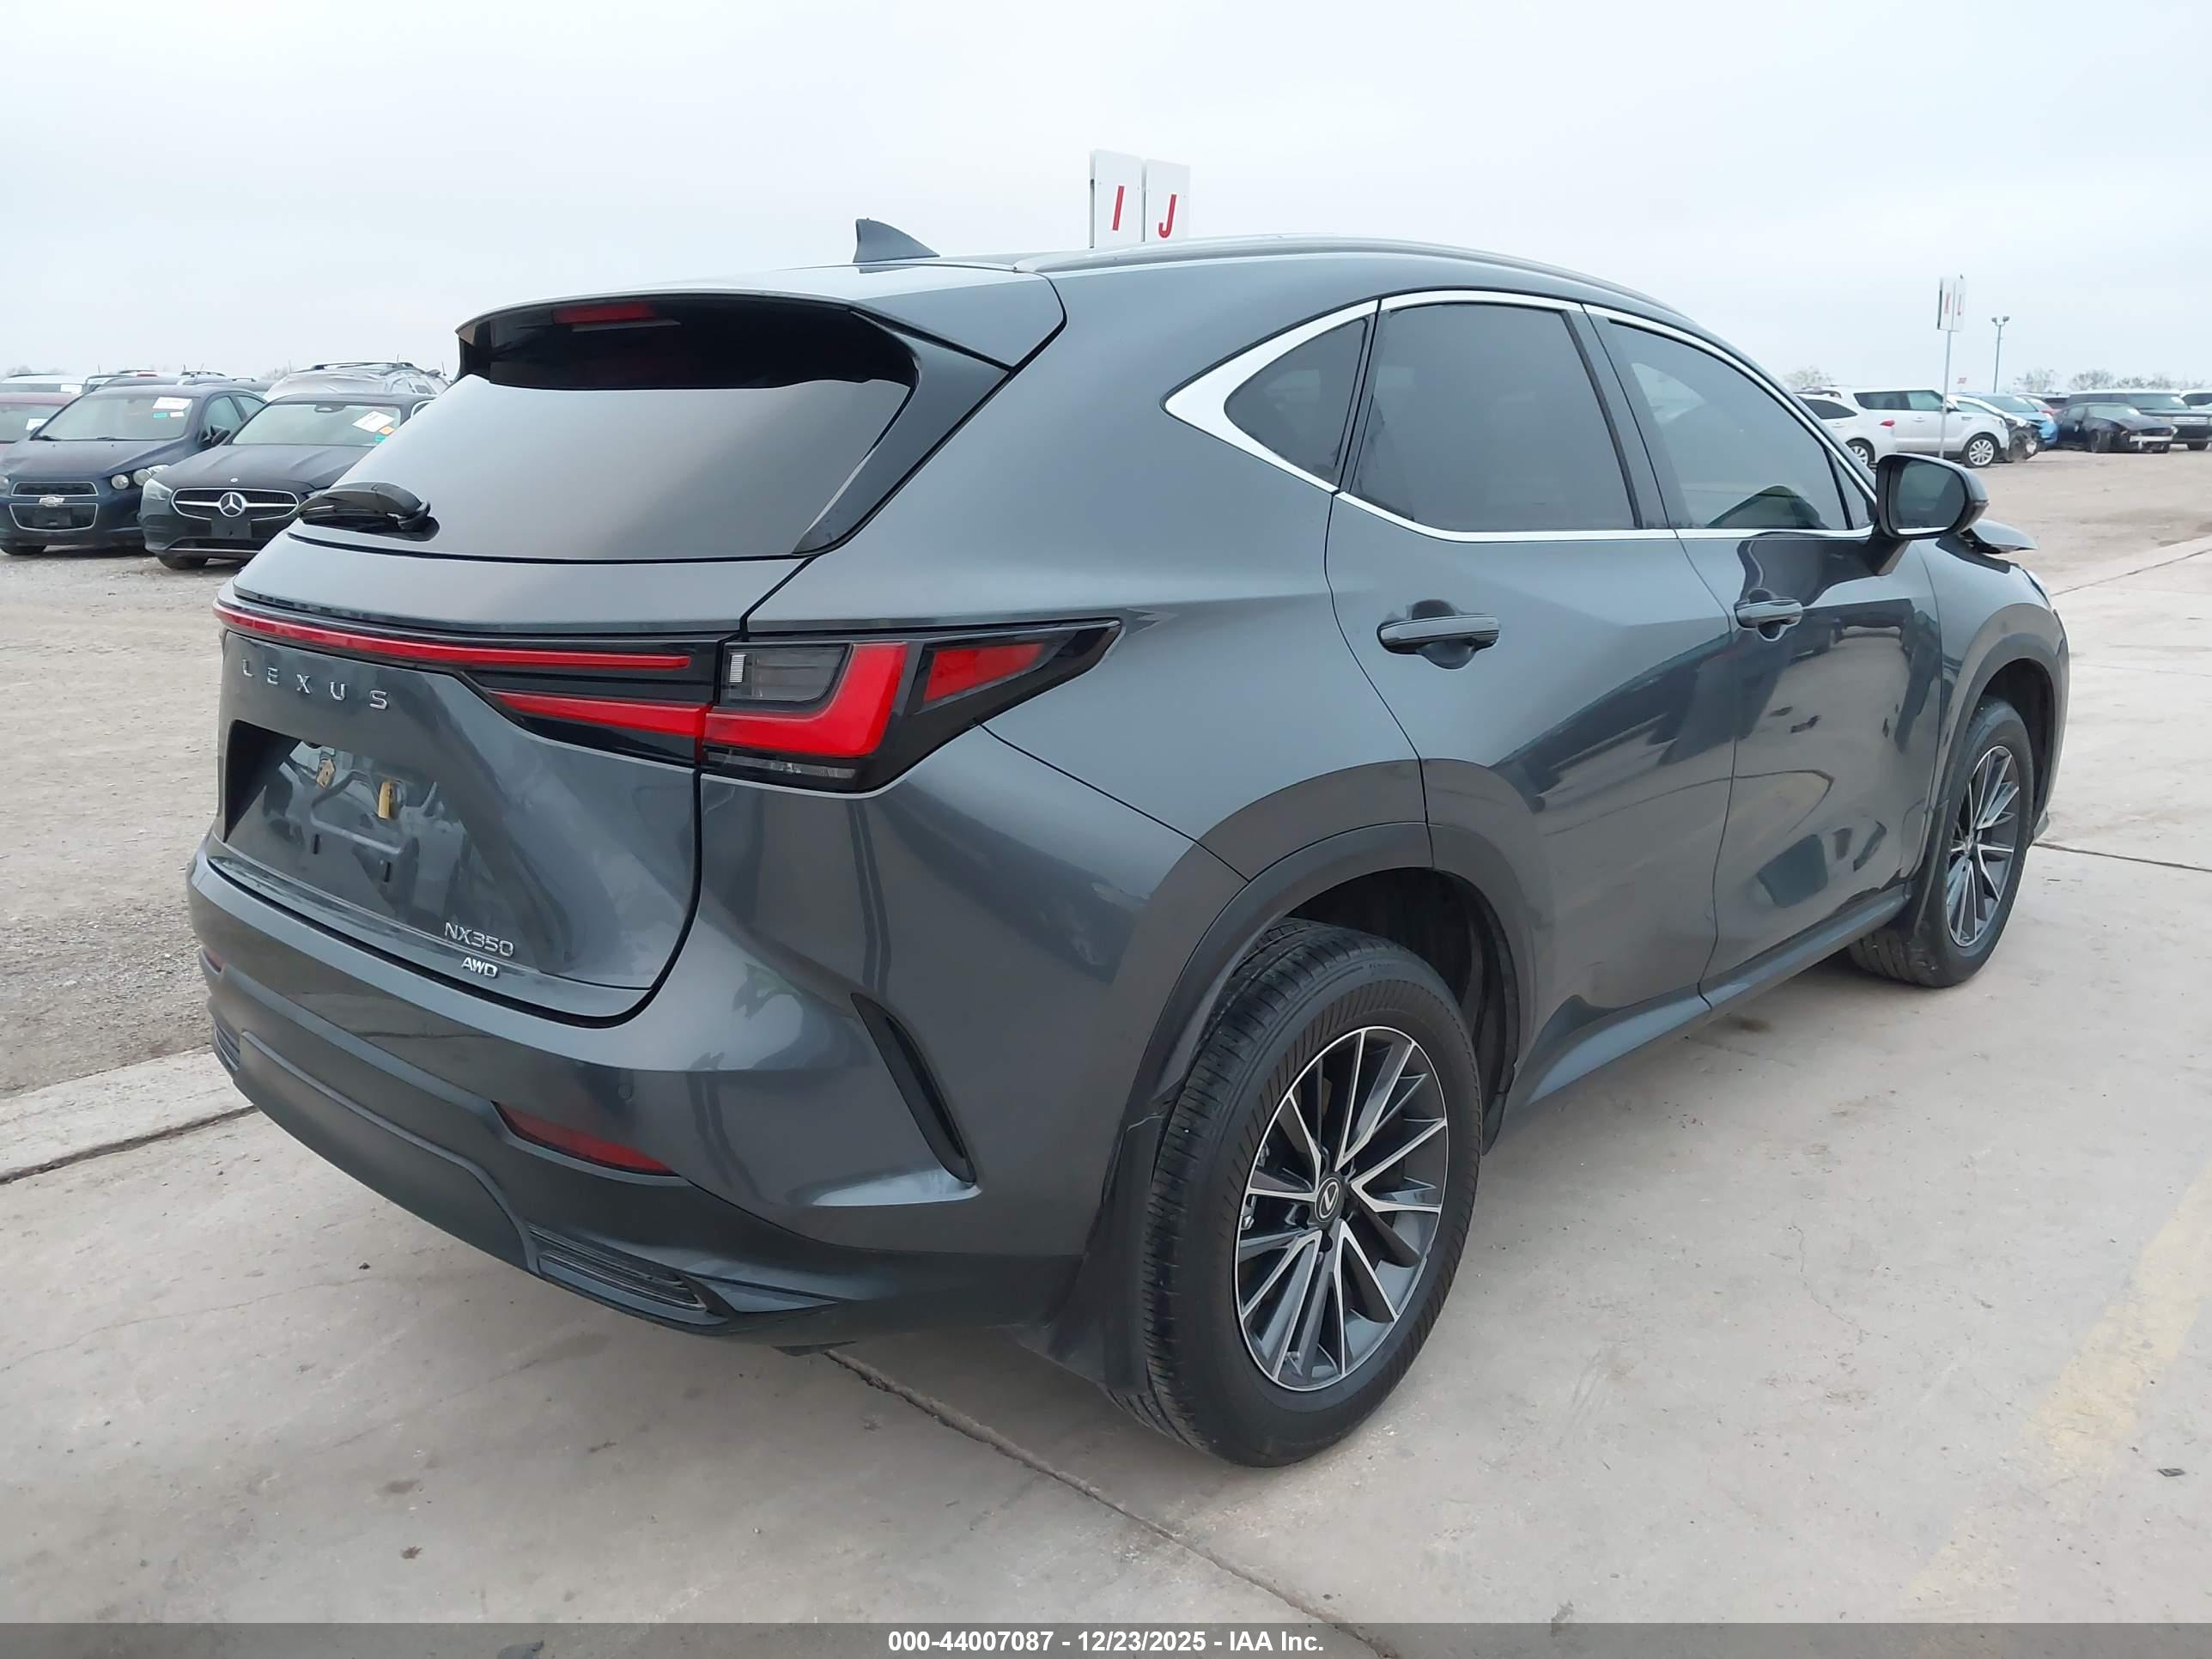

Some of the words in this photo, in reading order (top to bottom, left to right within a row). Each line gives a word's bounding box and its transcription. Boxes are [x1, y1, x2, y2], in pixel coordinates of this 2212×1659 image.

[1158, 194, 1177, 238] J
[242, 659, 388, 710] LEXUS
[444, 921, 514, 957] NX350
[460, 957, 499, 977] AWD
